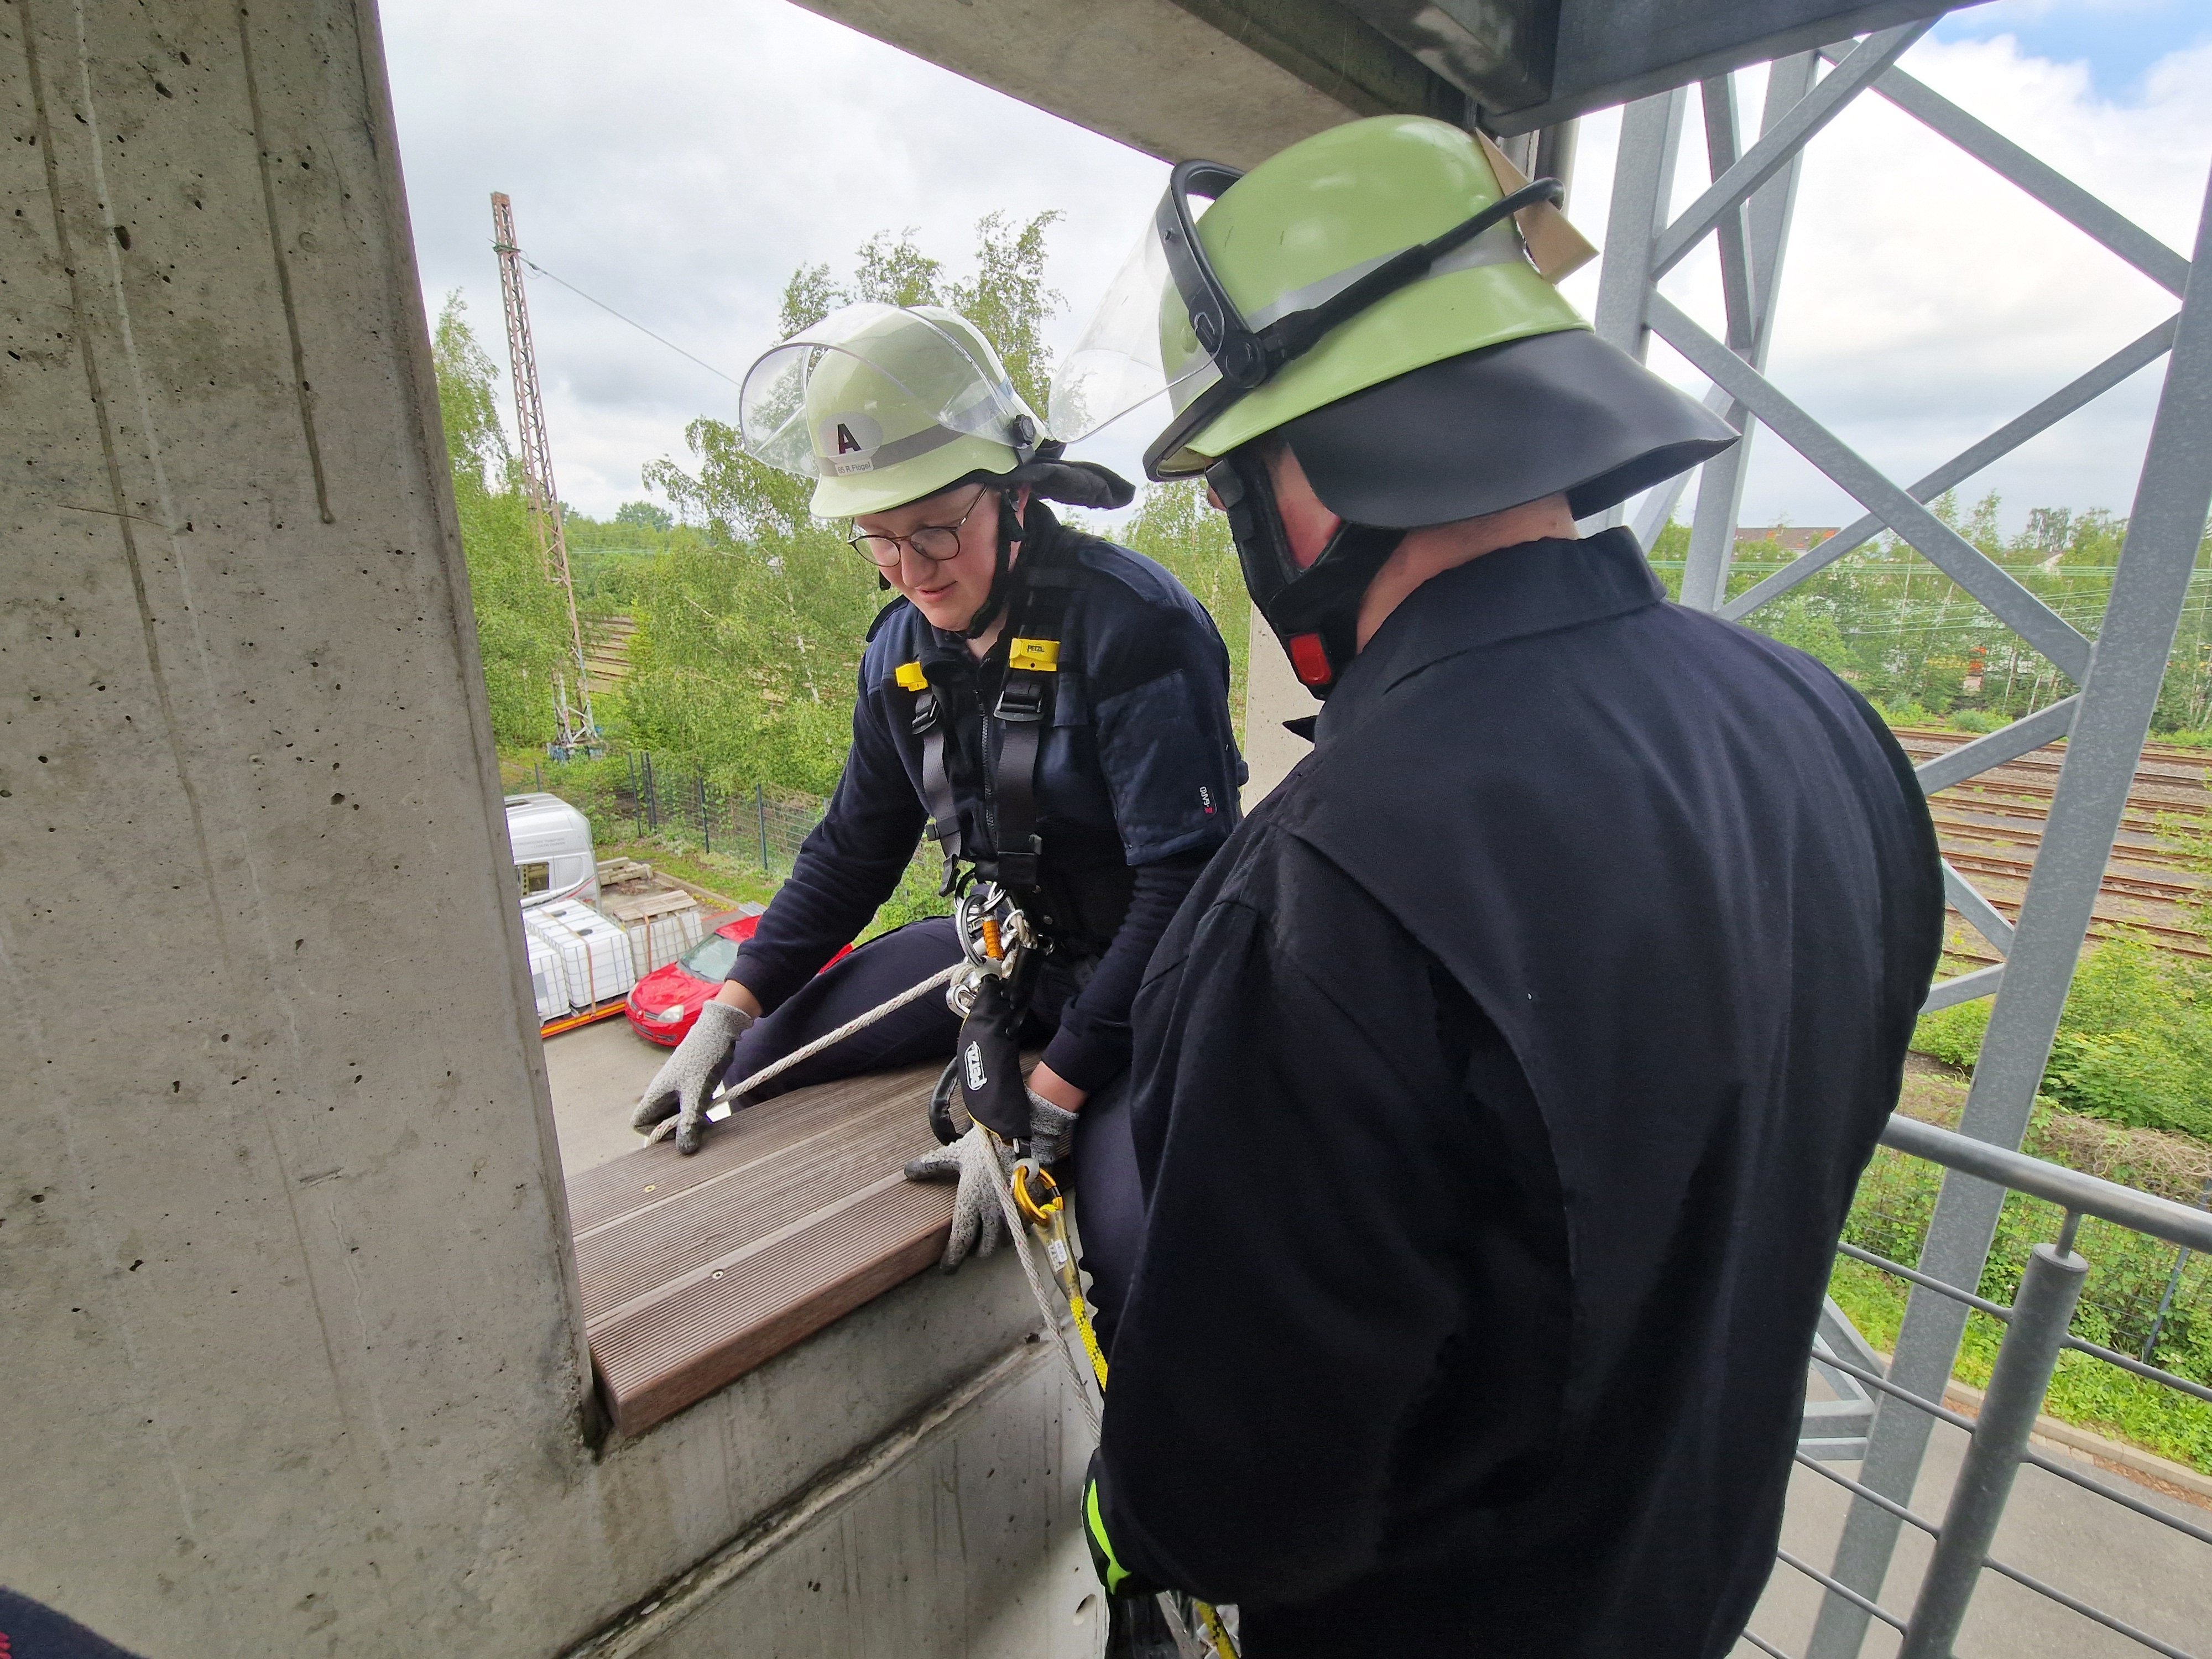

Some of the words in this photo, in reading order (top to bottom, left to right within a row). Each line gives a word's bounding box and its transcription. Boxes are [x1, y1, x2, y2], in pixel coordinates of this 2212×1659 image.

[837, 423, 862, 455] A
[1027, 644, 1045, 653] PETZL
[966, 1040, 988, 1089] PETZL
